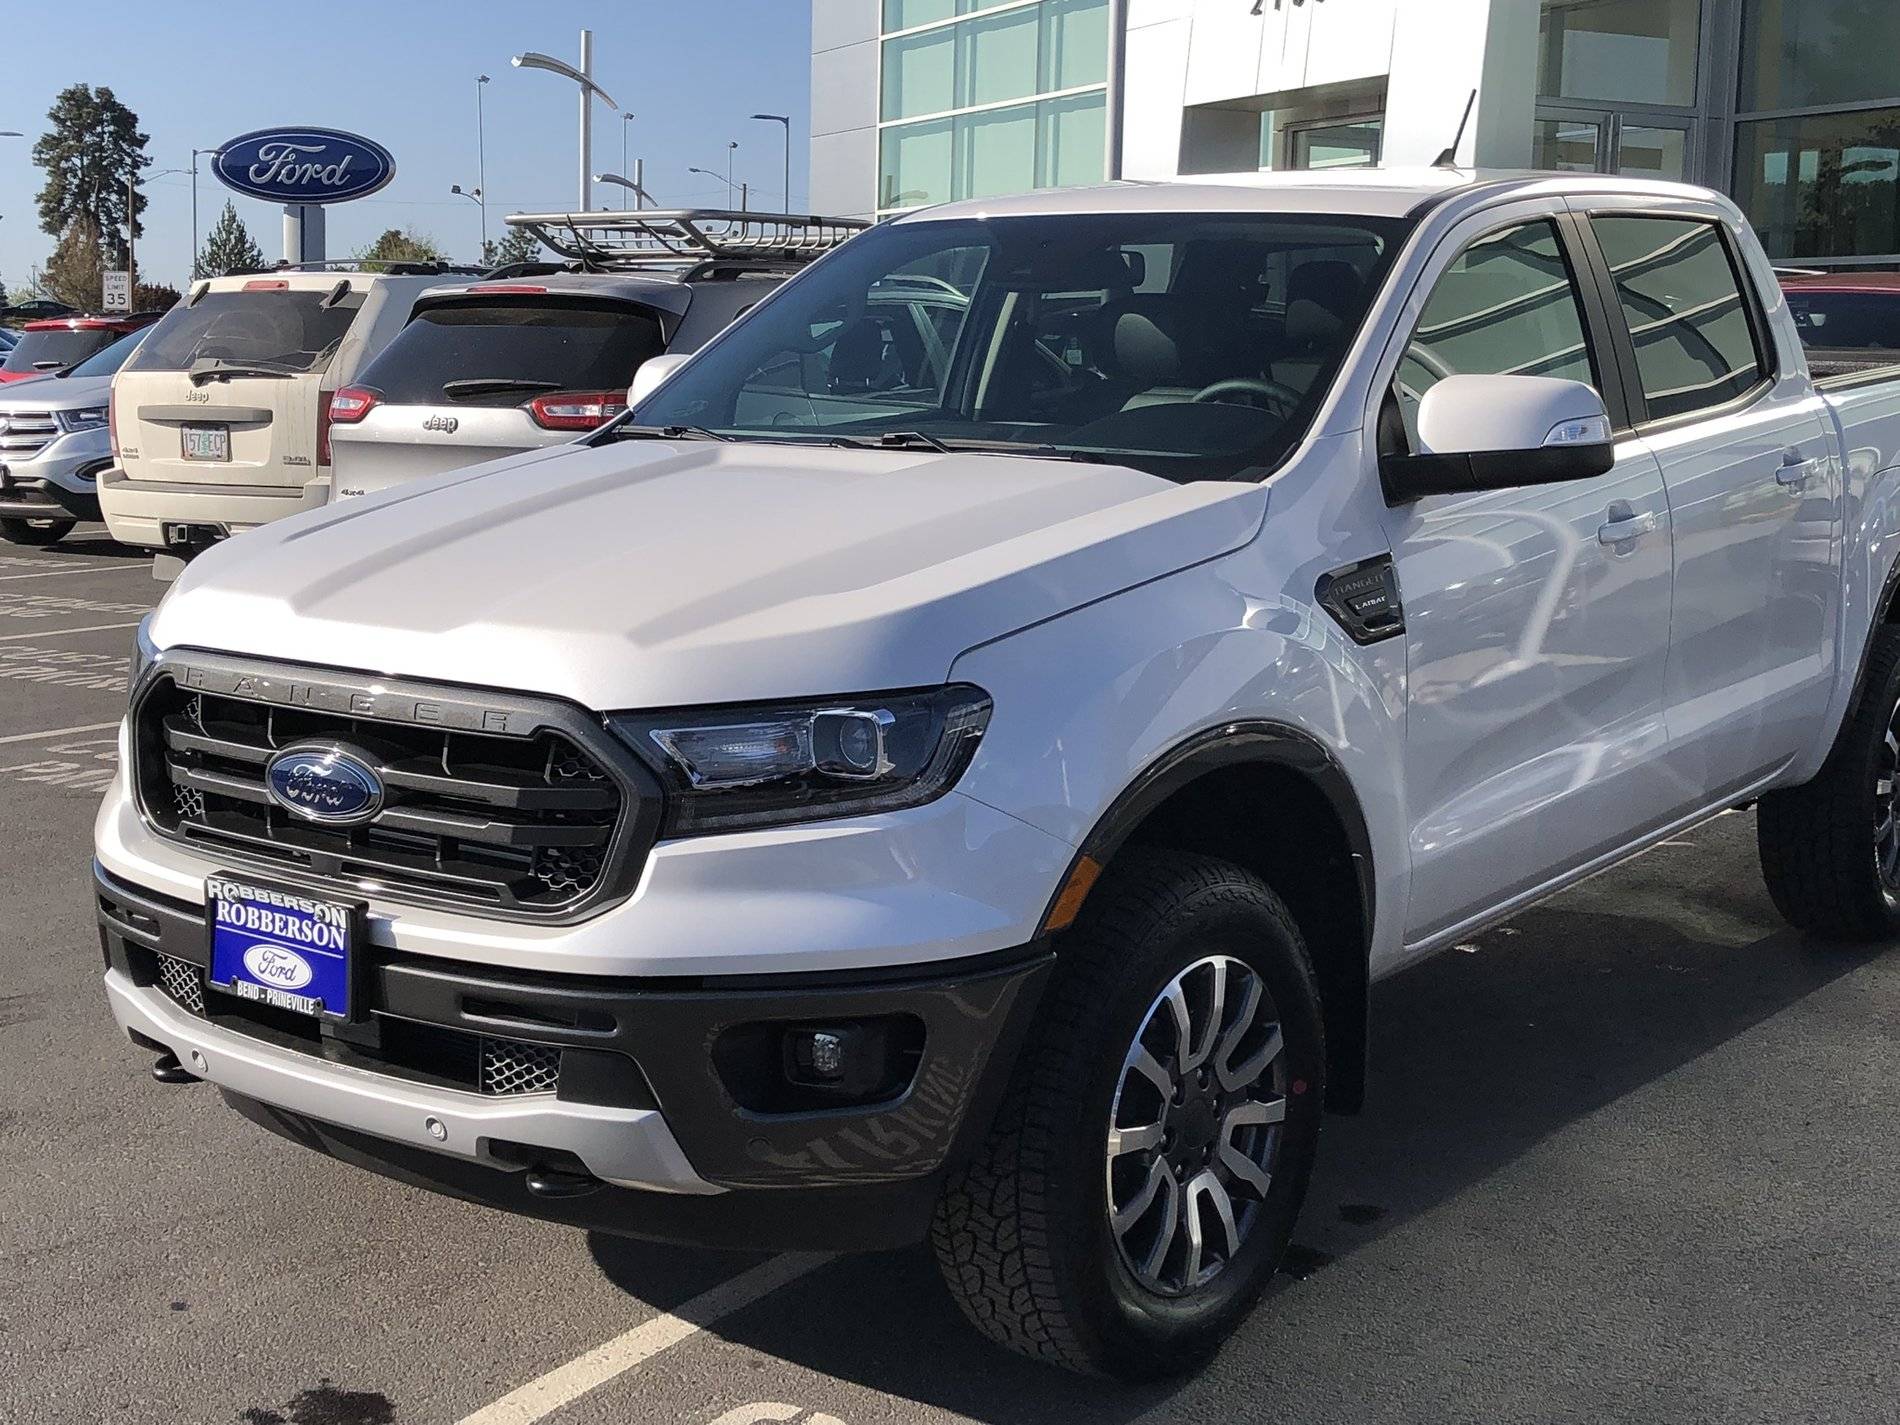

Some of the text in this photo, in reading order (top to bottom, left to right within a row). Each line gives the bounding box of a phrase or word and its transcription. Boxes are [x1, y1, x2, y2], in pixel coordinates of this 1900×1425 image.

[249, 142, 353, 186] Ford
[106, 293, 126, 305] 35
[186, 390, 209, 404] Jeep
[423, 415, 459, 434] Jeep
[185, 666, 512, 732] RANGER
[207, 879, 347, 929] ROBBERSON
[216, 900, 346, 951] ROBBERSON
[258, 949, 298, 982] Ford
[237, 981, 260, 1001] BEND
[266, 988, 315, 1015] PRINEVILLE
